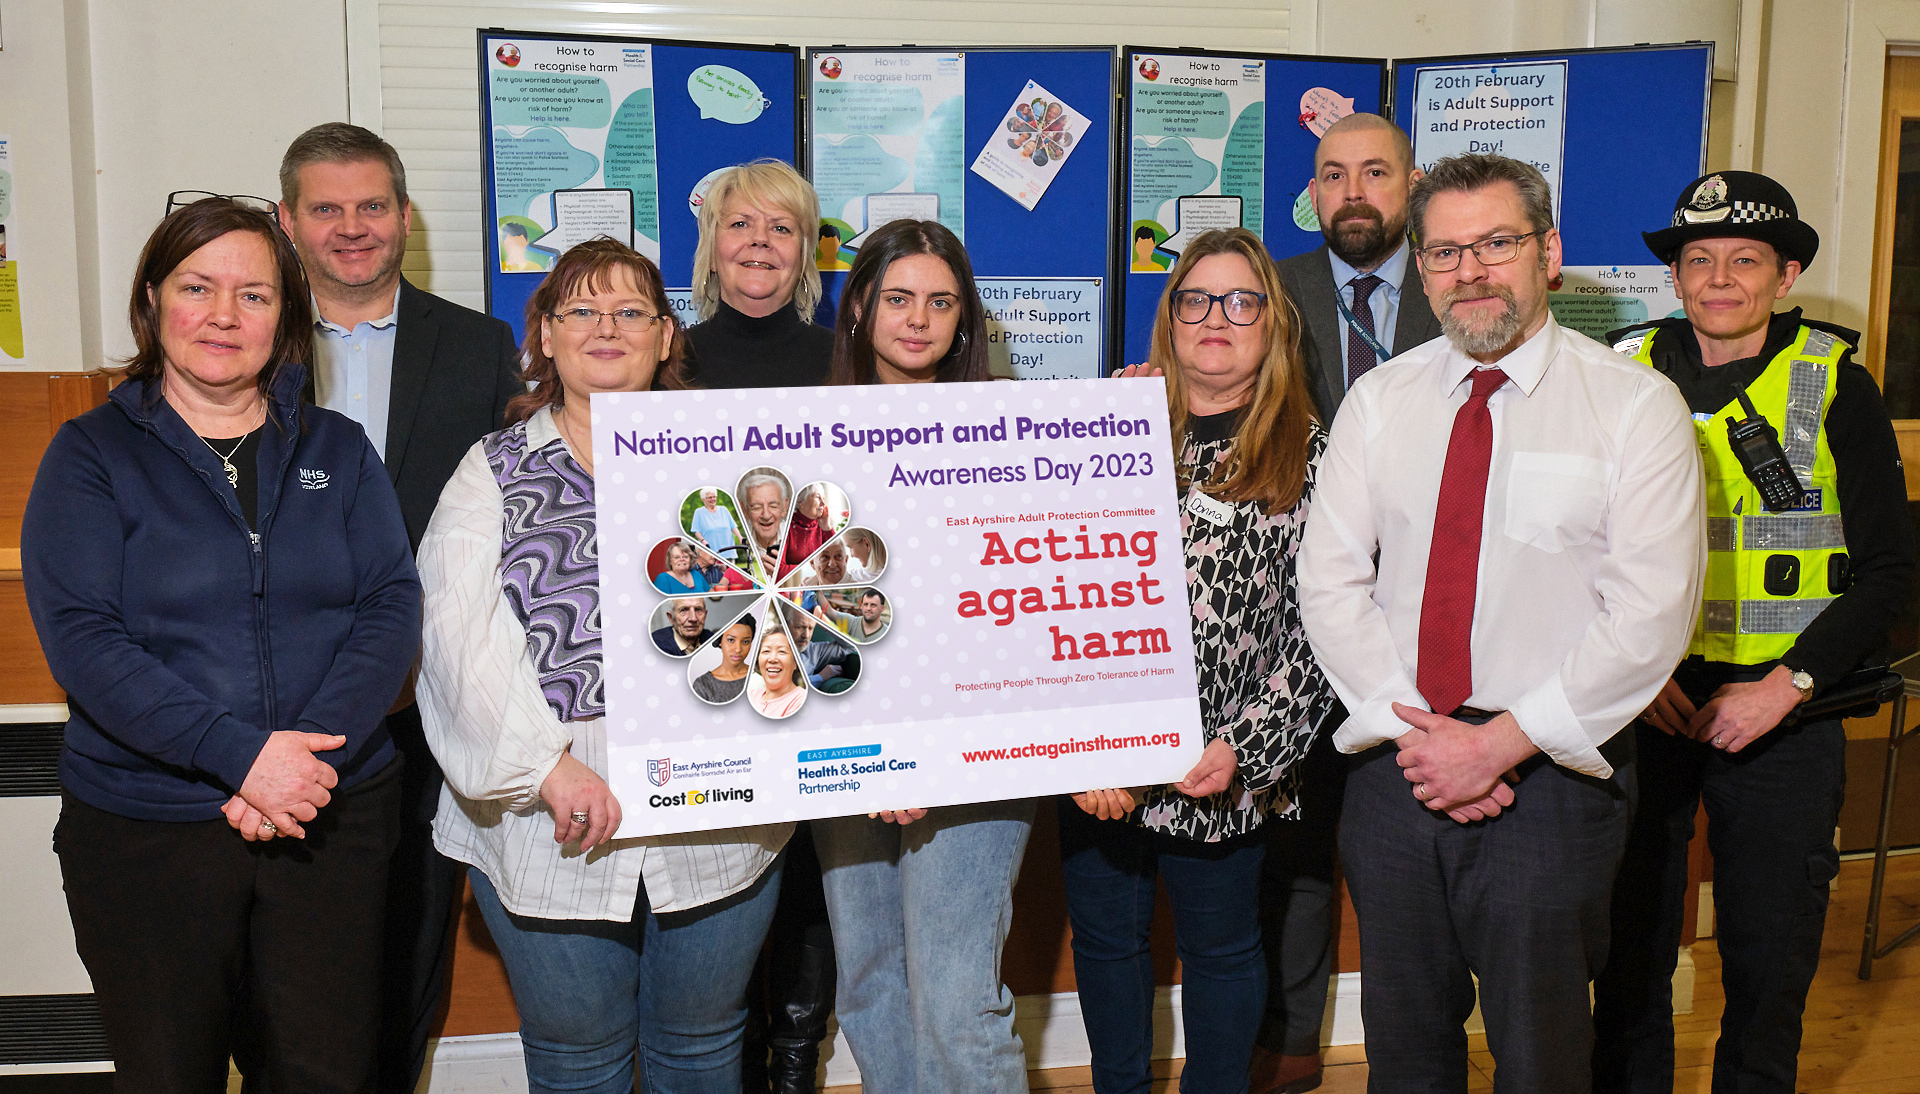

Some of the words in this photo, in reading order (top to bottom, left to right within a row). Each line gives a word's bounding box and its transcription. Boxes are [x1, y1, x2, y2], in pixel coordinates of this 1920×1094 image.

[557, 46, 581, 55] How
[583, 47, 595, 56] to
[534, 62, 586, 73] recognise
[589, 63, 618, 72] harm
[875, 58, 896, 66] How
[900, 58, 910, 66] to
[1190, 62, 1208, 70] How
[1211, 62, 1220, 71] to
[854, 73, 902, 83] recognise
[905, 73, 932, 81] harm
[1170, 76, 1212, 87] recognise
[1215, 77, 1238, 86] harm
[1435, 76, 1470, 89] 20th
[1476, 74, 1545, 88] February
[1429, 101, 1440, 110] is
[1444, 97, 1486, 110] Adult
[1490, 94, 1554, 111] Support
[1431, 120, 1458, 132] and
[1464, 117, 1545, 131] Protection
[1470, 140, 1503, 153] Day!
[1599, 271, 1621, 279] How
[1625, 271, 1636, 279] to
[977, 287, 1008, 299] 20th
[1014, 287, 1081, 303] February
[1575, 285, 1626, 295] recognise
[1629, 285, 1658, 293] harm
[985, 309, 1024, 322] Adult
[1029, 310, 1091, 325] Support
[1004, 331, 1083, 344] Protection
[1351, 320, 1363, 333] POLICE
[1362, 330, 1380, 350] SCOTLAND
[1011, 353, 1043, 368] Day!
[615, 426, 734, 456] National
[743, 423, 822, 451] Adult
[831, 422, 944, 453] Support
[952, 416, 1007, 443] and
[1016, 413, 1151, 440] Protection
[300, 468, 325, 480] NHS
[889, 463, 1026, 487] Awareness
[1034, 457, 1083, 485] Day
[1090, 452, 1153, 478] 2023
[947, 517, 970, 526] East
[973, 515, 1015, 527] Ayrshire
[1018, 513, 1045, 523] Adult
[1048, 510, 1100, 521] Protection
[1102, 507, 1155, 518] Committee
[1190, 498, 1223, 521] Donna
[980, 525, 1158, 567] Acting
[958, 572, 1164, 626] against
[1049, 625, 1172, 661] harm
[955, 680, 1001, 692] Protecting
[1004, 678, 1034, 689] People
[1035, 675, 1074, 685] Through
[1075, 673, 1095, 683] Zero
[1097, 669, 1139, 680] Tolerance
[1140, 669, 1149, 677] of
[1151, 666, 1175, 676] Harm
[807, 751, 828, 760] EAST
[831, 747, 872, 758] AYRSHIRE
[962, 733, 1181, 763] www.actagainstharm.org
[673, 763, 689, 771] East
[691, 761, 723, 771] Ayrshire
[724, 757, 752, 768] Council
[798, 766, 839, 779] Health
[840, 764, 850, 775] &
[851, 761, 886, 775] Social
[889, 759, 917, 771] Care
[799, 779, 861, 795] Partnership
[649, 791, 686, 808] Cost
[695, 790, 710, 804] of
[713, 787, 754, 803] living
